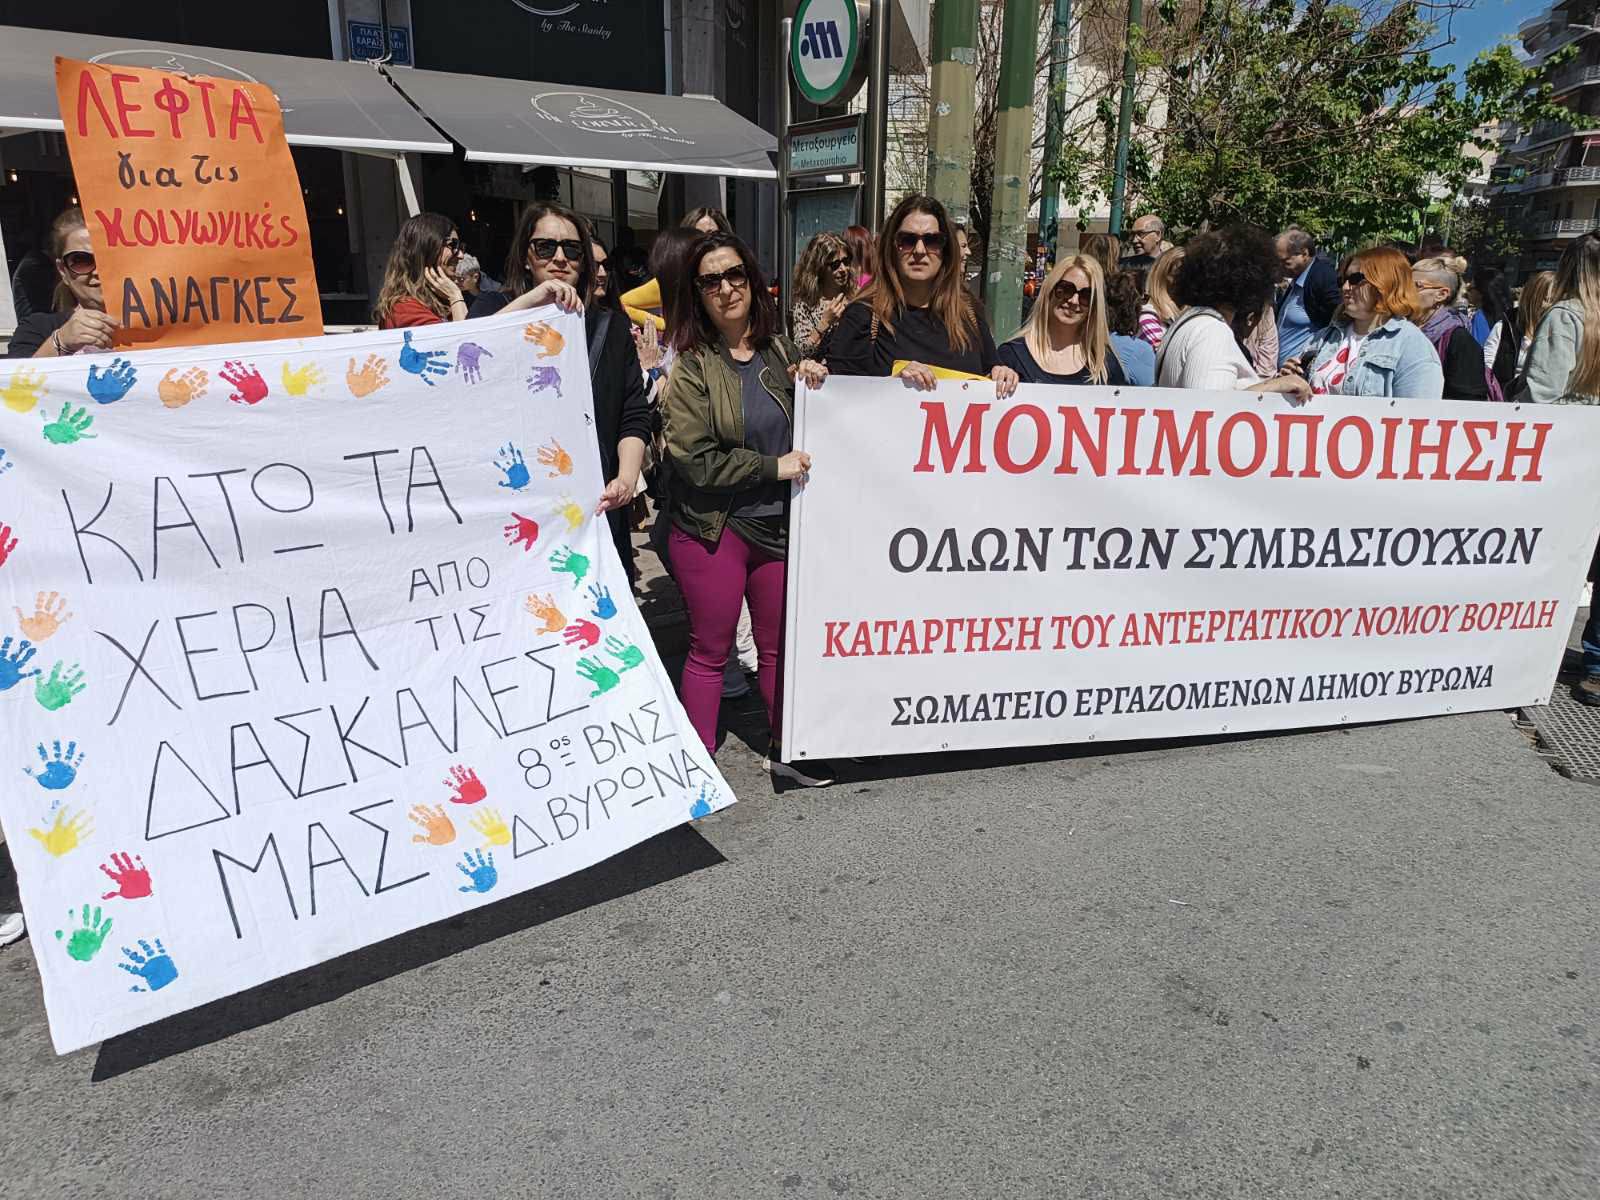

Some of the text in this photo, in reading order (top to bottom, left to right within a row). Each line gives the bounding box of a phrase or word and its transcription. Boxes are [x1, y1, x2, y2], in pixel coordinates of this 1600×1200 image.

[557, 20, 576, 32] The
[578, 23, 611, 40] Stanley
[77, 69, 264, 144] ΛΕΦΤΑ
[117, 150, 239, 190] για τις
[122, 275, 304, 328] ΑΝΑΓΚΕΣ
[913, 402, 1553, 482] ΜΟΝΙΜΟΠΟΙΗΣΗ
[343, 446, 463, 535] ΤΑ
[409, 556, 491, 602] ΑΠΟ
[888, 526, 1543, 574] ΟΛΩΝ ΤΩΝ ΣΥΜΒΑΣΙΟΥΧΩΝ
[94, 588, 381, 726] ΧΕΡΙΑ
[414, 604, 502, 651] ΤΙΣ
[822, 599, 1559, 659] ΚΑΤΑΡΓΗΣΗ ΤΟΥ ΑΝΤΕΡΓΑΤΙΚΟΥ ΝΟΜΟΥ ΒΟΡΙΔΗ
[891, 664, 1495, 727] ΣΩΜΑΤΕΙΟ ΕΡΓΑΖΟΜΕΝΩΝ ΔΗΜΟΥ ΒΥΡΩΝΑ
[144, 643, 590, 841] ΔΑΣΚΑΛΕΣ
[212, 799, 431, 939] ΜΑΣ
